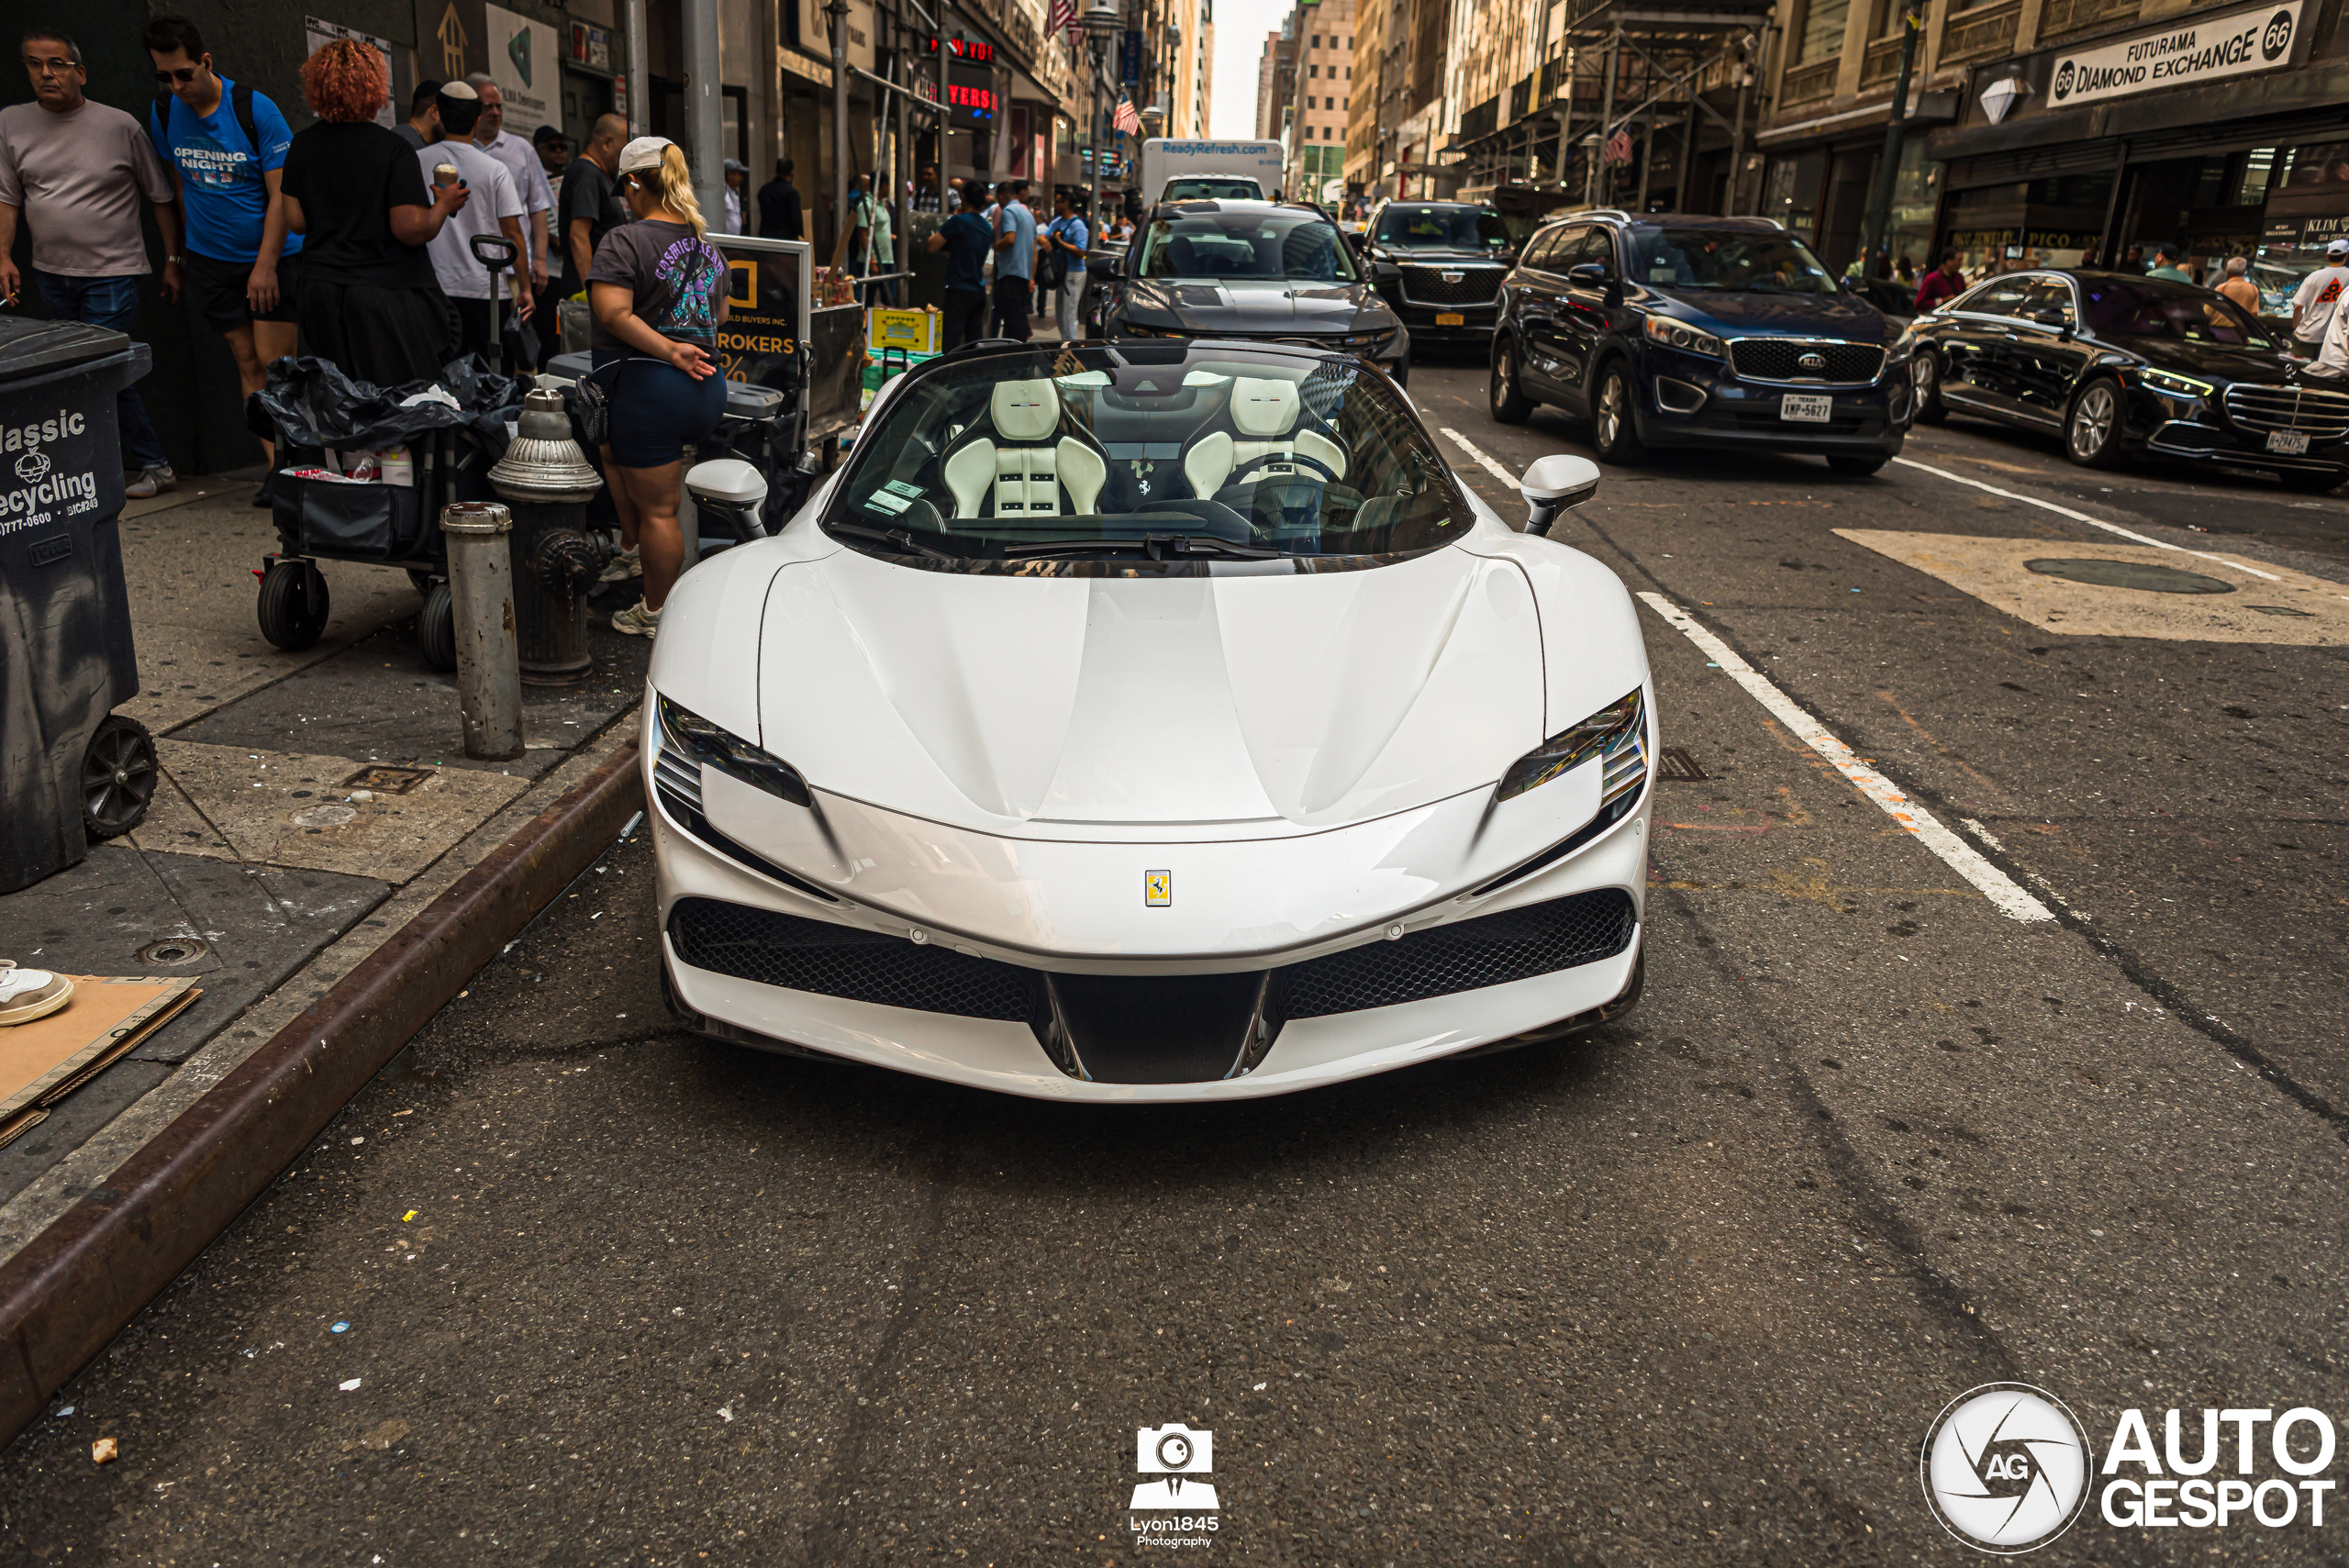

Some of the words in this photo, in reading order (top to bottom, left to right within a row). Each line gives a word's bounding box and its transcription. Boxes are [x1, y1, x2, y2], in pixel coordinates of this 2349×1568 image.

[2127, 31, 2196, 62] FUTURAMA
[2056, 71, 2074, 90] 66
[2076, 65, 2146, 94] DIAMOND
[2153, 27, 2258, 79] EXCHANGE
[2265, 21, 2290, 50] 66
[948, 84, 990, 108] YERS
[174, 147, 247, 161] OPENING
[1163, 142, 1267, 156] ReadyRefresh.com
[182, 158, 235, 172] NIGHT
[2308, 218, 2339, 231] KLIM
[2029, 232, 2071, 248] PICO
[742, 316, 771, 325] BUYERS
[718, 333, 794, 355] ROKERS
[1803, 357, 1821, 367] KIA
[0, 409, 85, 453] lassic
[0, 472, 96, 516] ecycling
[0, 512, 51, 537] )777-0600
[67, 497, 98, 516] BIC#249
